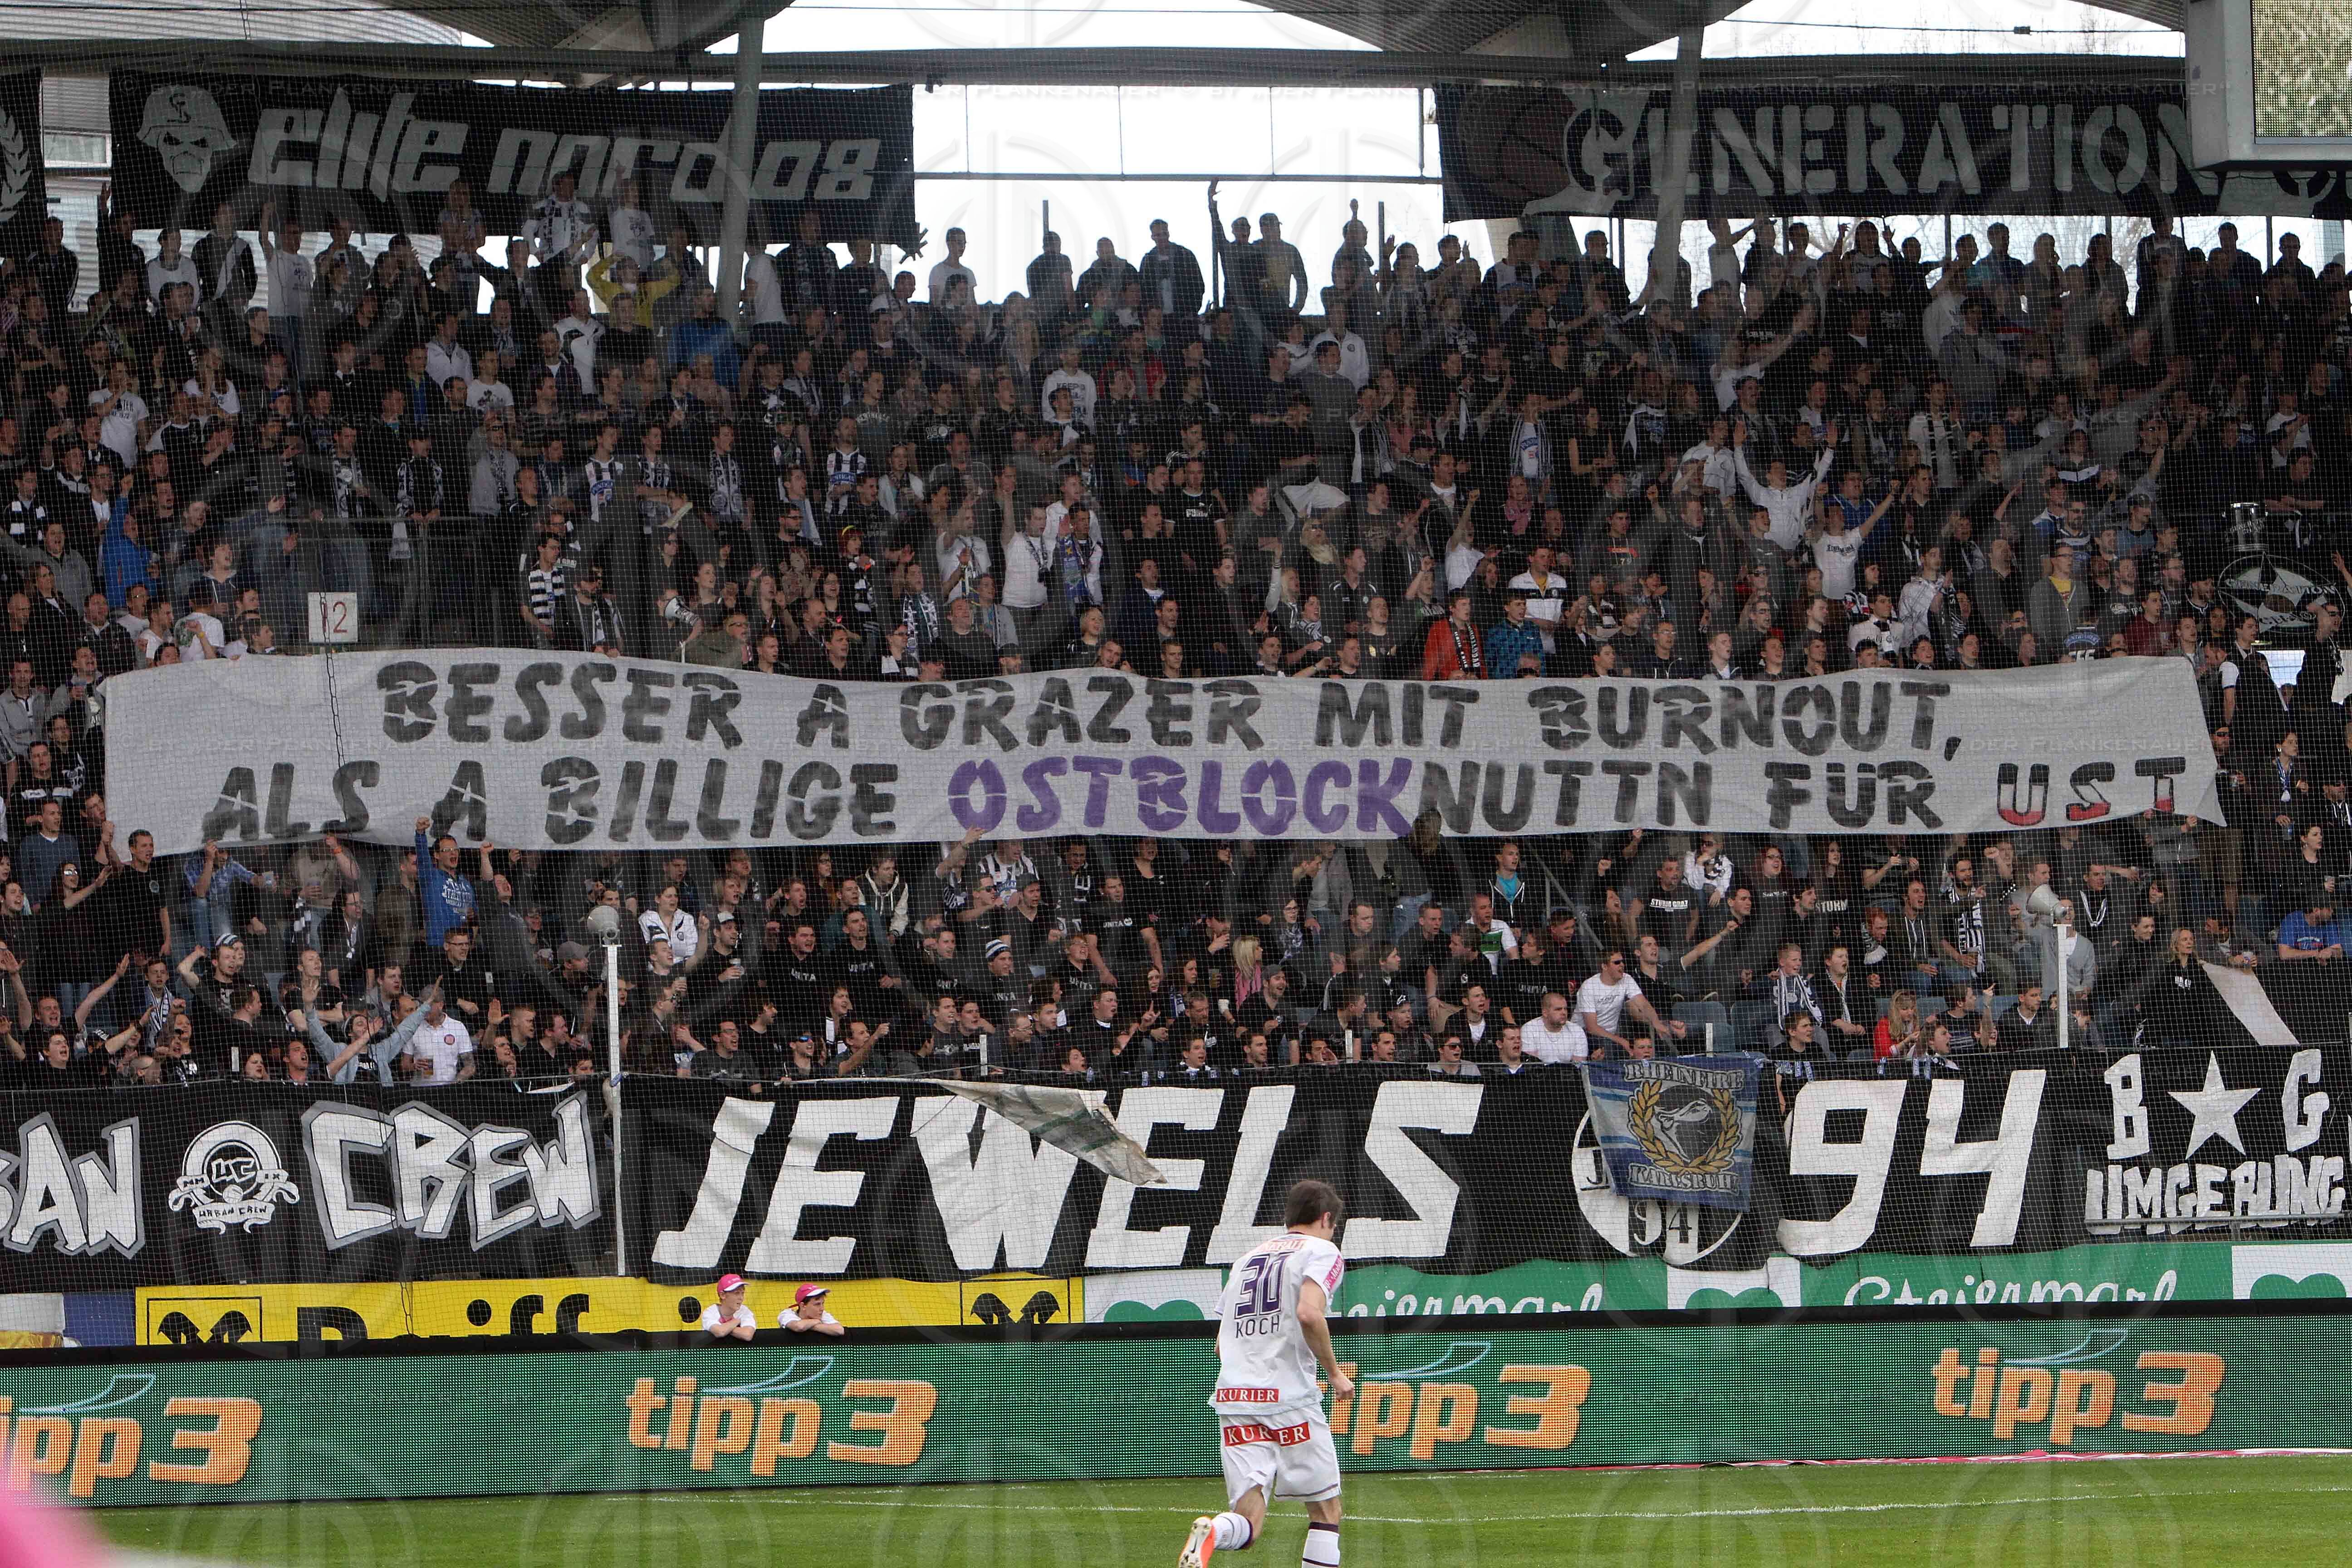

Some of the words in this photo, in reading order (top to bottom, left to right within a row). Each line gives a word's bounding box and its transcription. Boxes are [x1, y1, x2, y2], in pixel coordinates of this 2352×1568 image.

[377, 661, 743, 749] BESSER
[796, 684, 849, 749] A
[900, 676, 1264, 752] GRAZER
[1314, 682, 1480, 748] MIT
[1528, 681, 1961, 761] BURNOUT,
[202, 760, 381, 843] ALS
[430, 760, 487, 841] A
[541, 756, 898, 844] BILLIGE
[948, 755, 1712, 837] OSTBLOCKNUTTN
[1765, 760, 1944, 829] FÜR
[1997, 757, 2186, 827] UST
[1626, 1062, 1743, 1089] RHEINFIRE
[2281, 1049, 2330, 1152] G
[0, 1112, 145, 1259] AN
[301, 1089, 601, 1251] CREW
[651, 1080, 1485, 1273] JEWELS
[1777, 1069, 2046, 1256] 94
[199, 1207, 234, 1217] URBAN
[239, 1205, 267, 1215] CREW
[1234, 1250, 1295, 1320] 30
[1235, 1316, 1280, 1338] KOCH
[1218, 1389, 1275, 1401] KURIER
[1226, 1423, 1307, 1445] KURER
